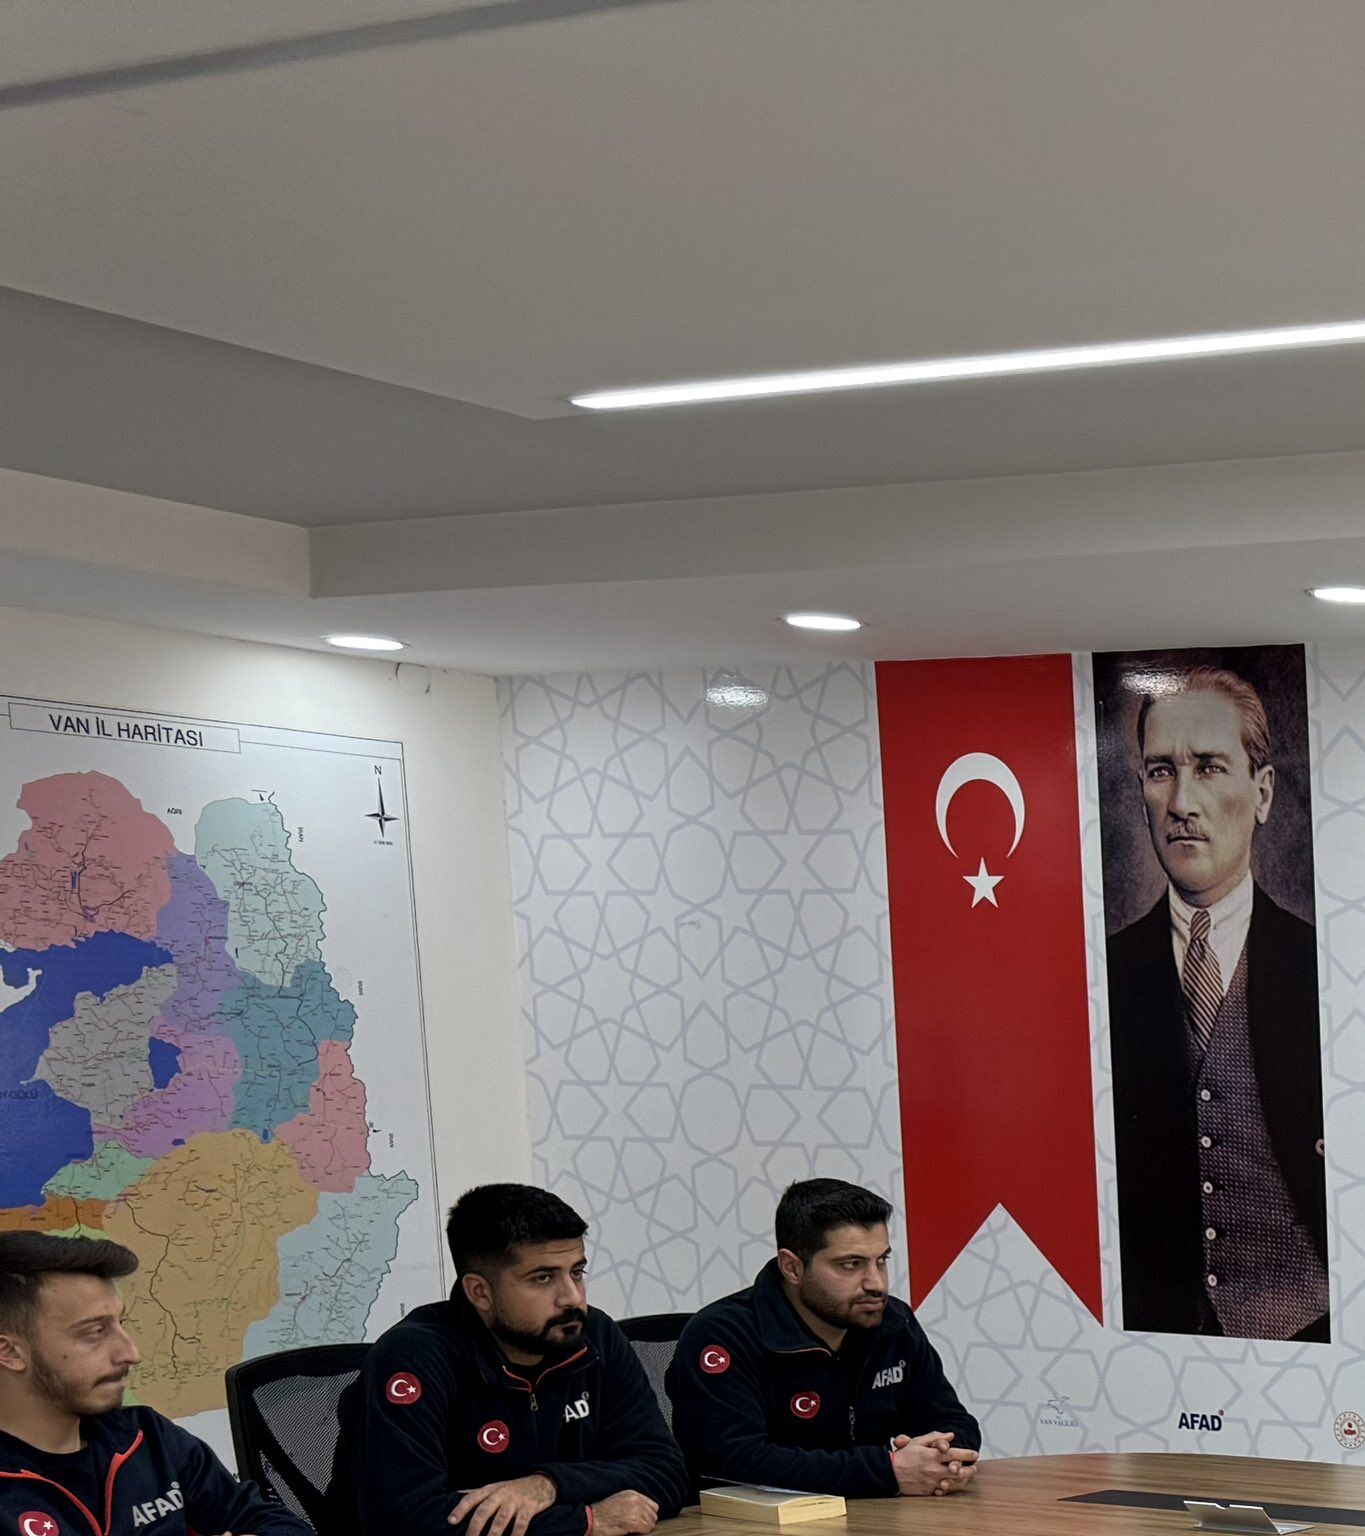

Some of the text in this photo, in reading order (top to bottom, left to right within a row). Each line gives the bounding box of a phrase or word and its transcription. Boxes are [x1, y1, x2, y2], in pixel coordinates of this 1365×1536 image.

[49, 714, 204, 747] VAN İL HARİTASI
[374, 765, 382, 775] N
[871, 1366, 904, 1390] AFAD
[564, 1399, 590, 1423] AD
[1178, 1412, 1222, 1431] AFAD
[131, 1488, 184, 1528] AFAD
